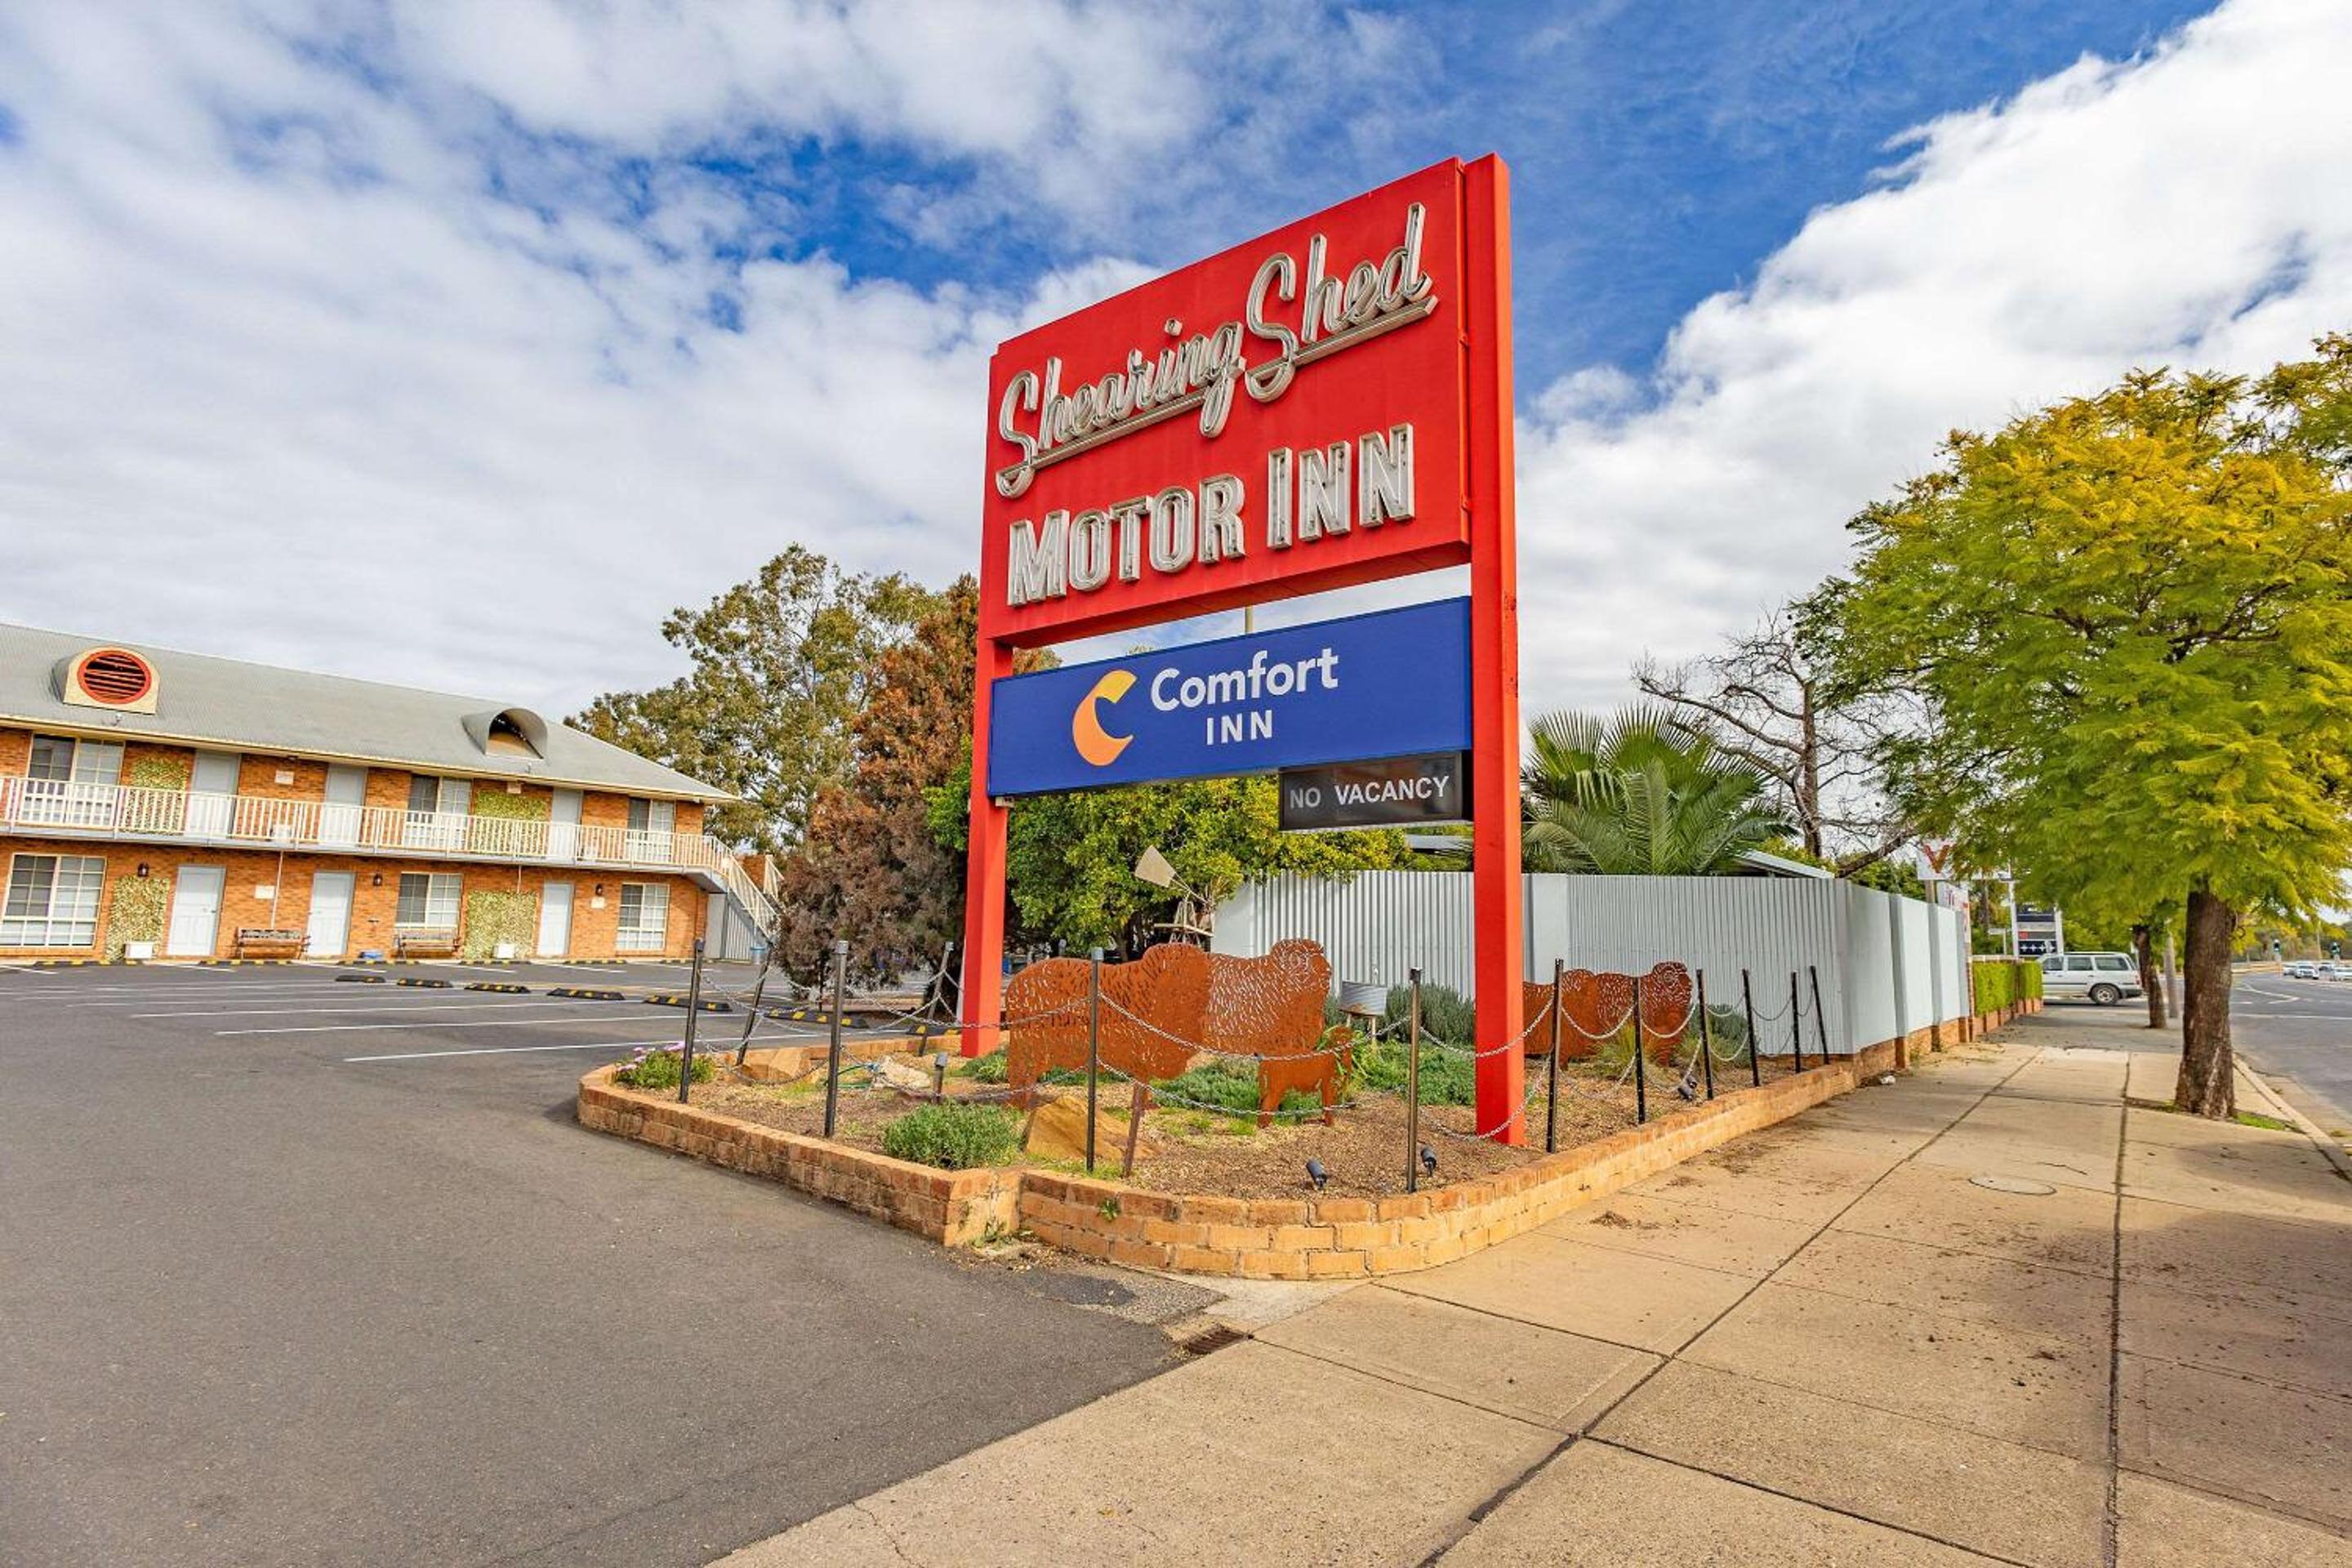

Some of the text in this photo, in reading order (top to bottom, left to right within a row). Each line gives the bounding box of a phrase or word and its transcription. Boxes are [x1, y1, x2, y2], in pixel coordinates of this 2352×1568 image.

[996, 202, 1439, 499] Shearing Shed
[1007, 422, 1415, 608] MOTOR INN
[1151, 647, 1339, 711] Comfort
[1206, 710, 1273, 746] INN
[1290, 775, 1449, 808] NO VACANCY
